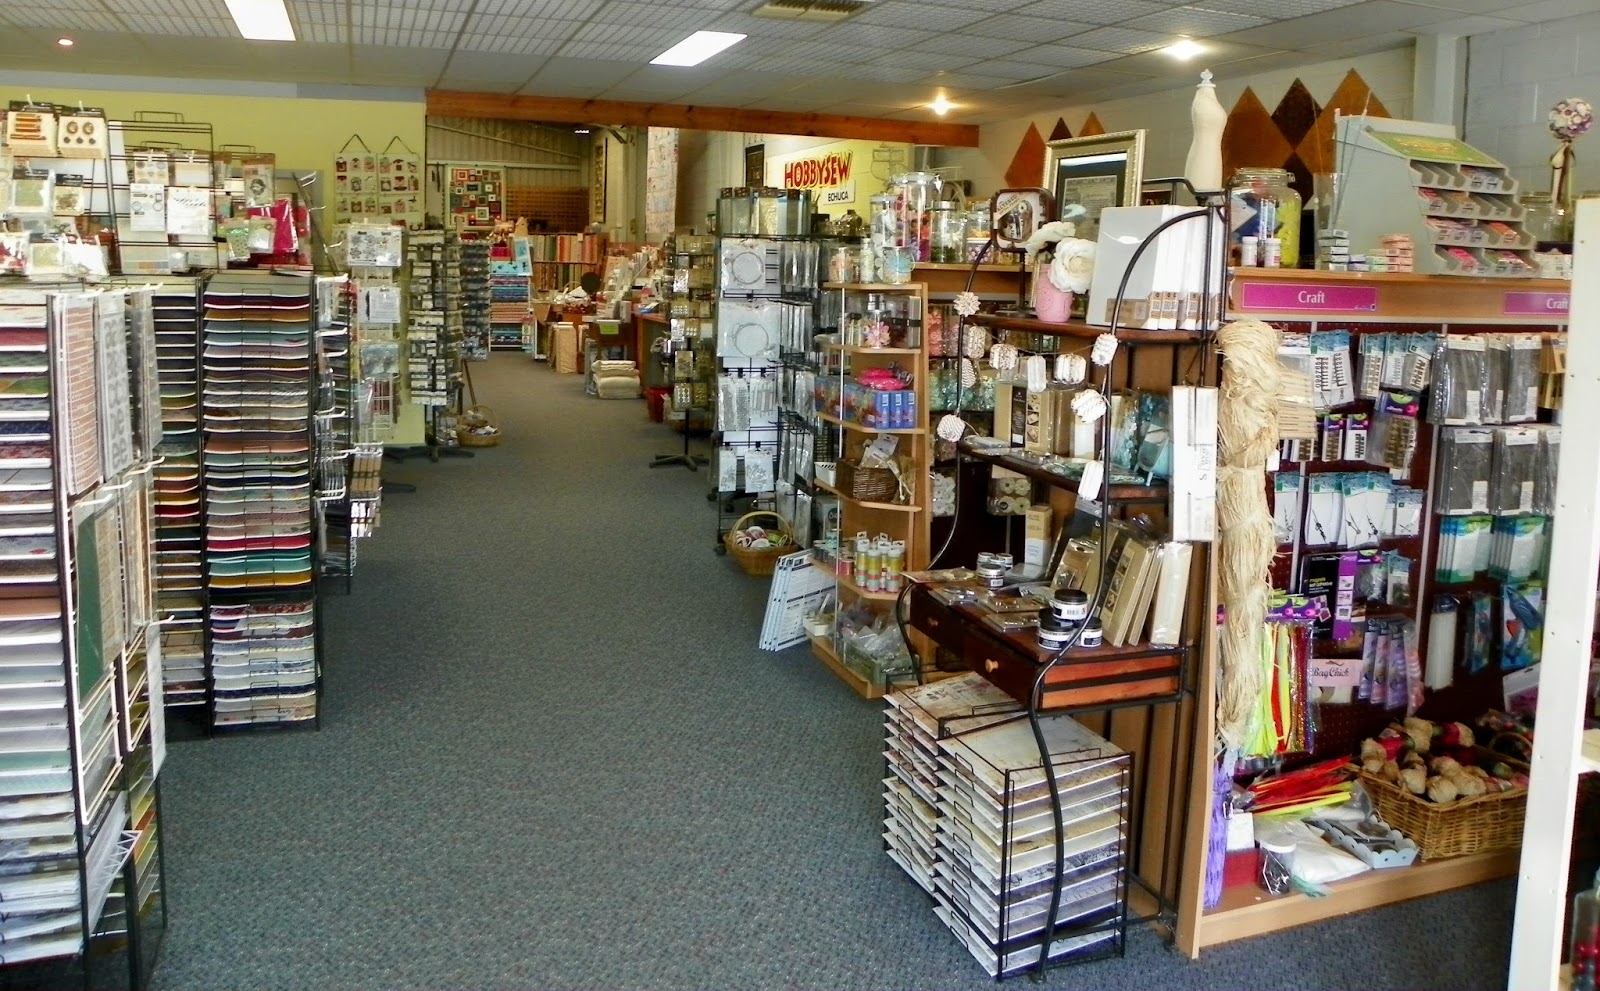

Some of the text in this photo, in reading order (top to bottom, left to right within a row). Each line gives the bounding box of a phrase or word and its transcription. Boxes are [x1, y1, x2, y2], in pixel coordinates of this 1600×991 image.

[784, 152, 852, 189] HOBBYSEW
[827, 191, 849, 202] ECHUCA
[1297, 290, 1326, 304] Craft
